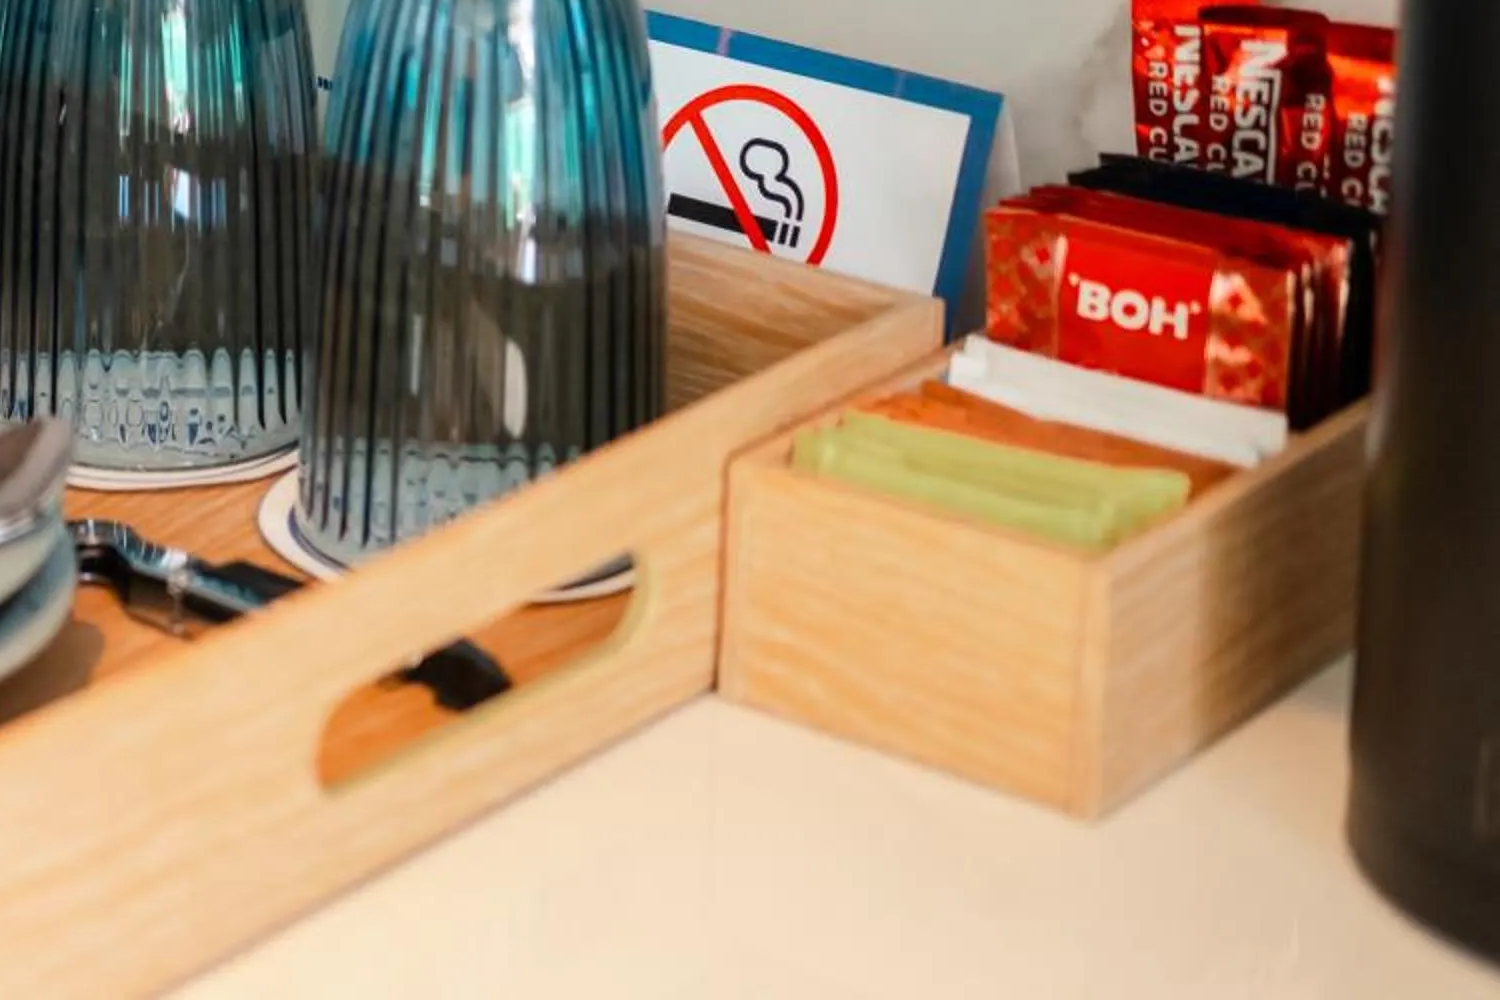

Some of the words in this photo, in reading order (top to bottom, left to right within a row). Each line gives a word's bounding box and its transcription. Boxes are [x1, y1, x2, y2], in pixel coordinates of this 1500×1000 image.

[1149, 61, 1167, 116] RED
[1209, 75, 1232, 131] RED
[1231, 38, 1288, 184] NESCA
[1149, 126, 1167, 163] CU
[1301, 93, 1326, 150] RED
[1344, 112, 1368, 168] RED
